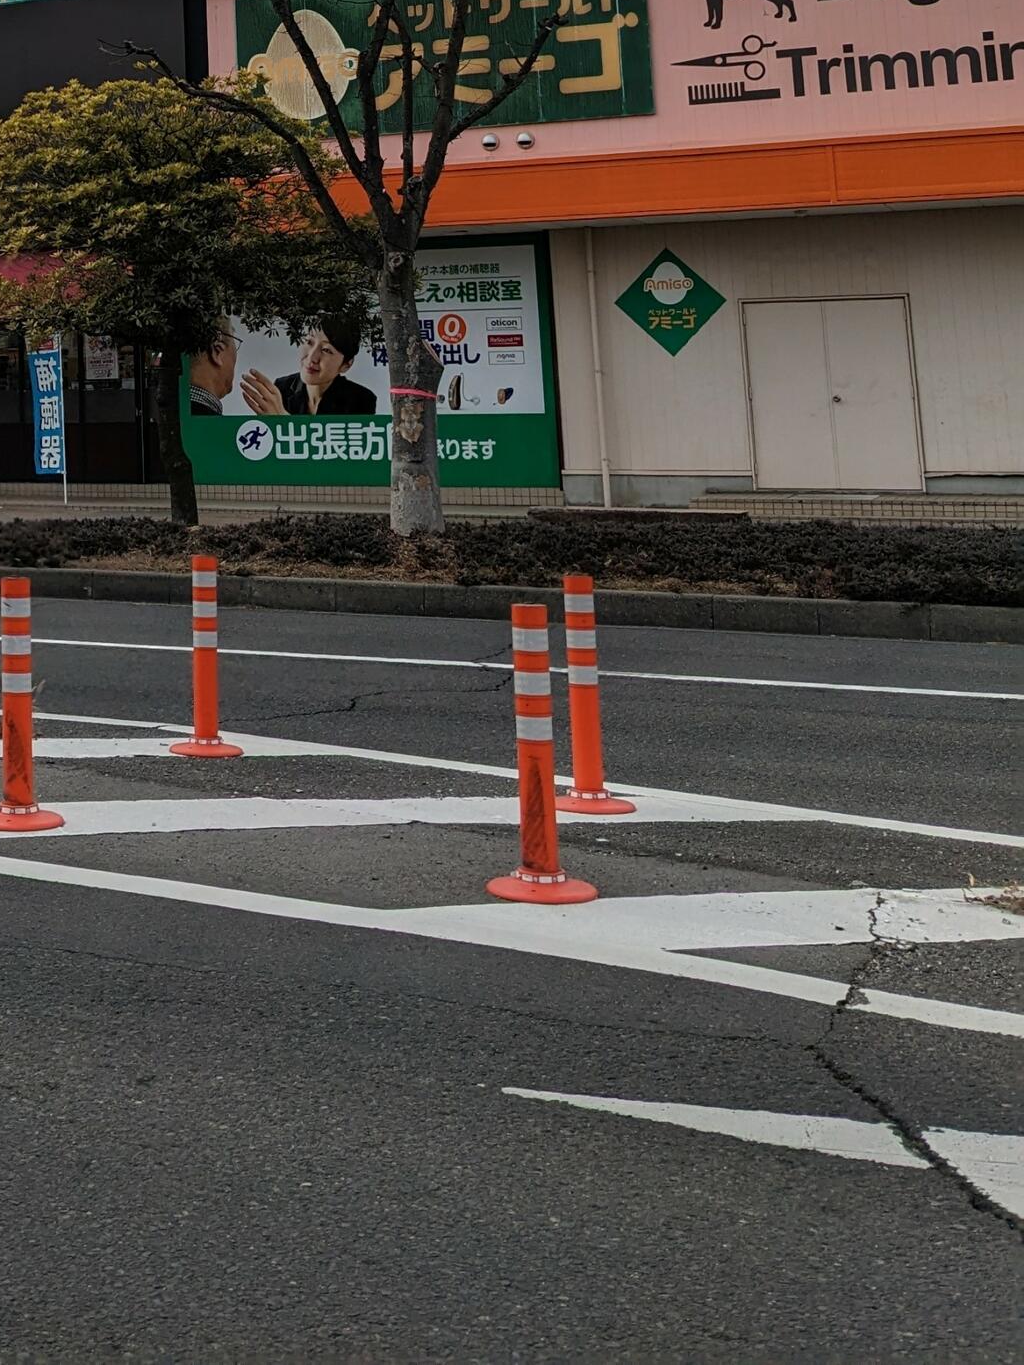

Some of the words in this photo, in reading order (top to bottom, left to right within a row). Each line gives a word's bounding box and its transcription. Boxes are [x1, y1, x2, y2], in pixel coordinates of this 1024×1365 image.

[374, 11, 640, 113] アミーゴ
[490, 317, 518, 327] oticon
[647, 314, 697, 330] アミーゴ
[275, 421, 392, 461] 出張訪
